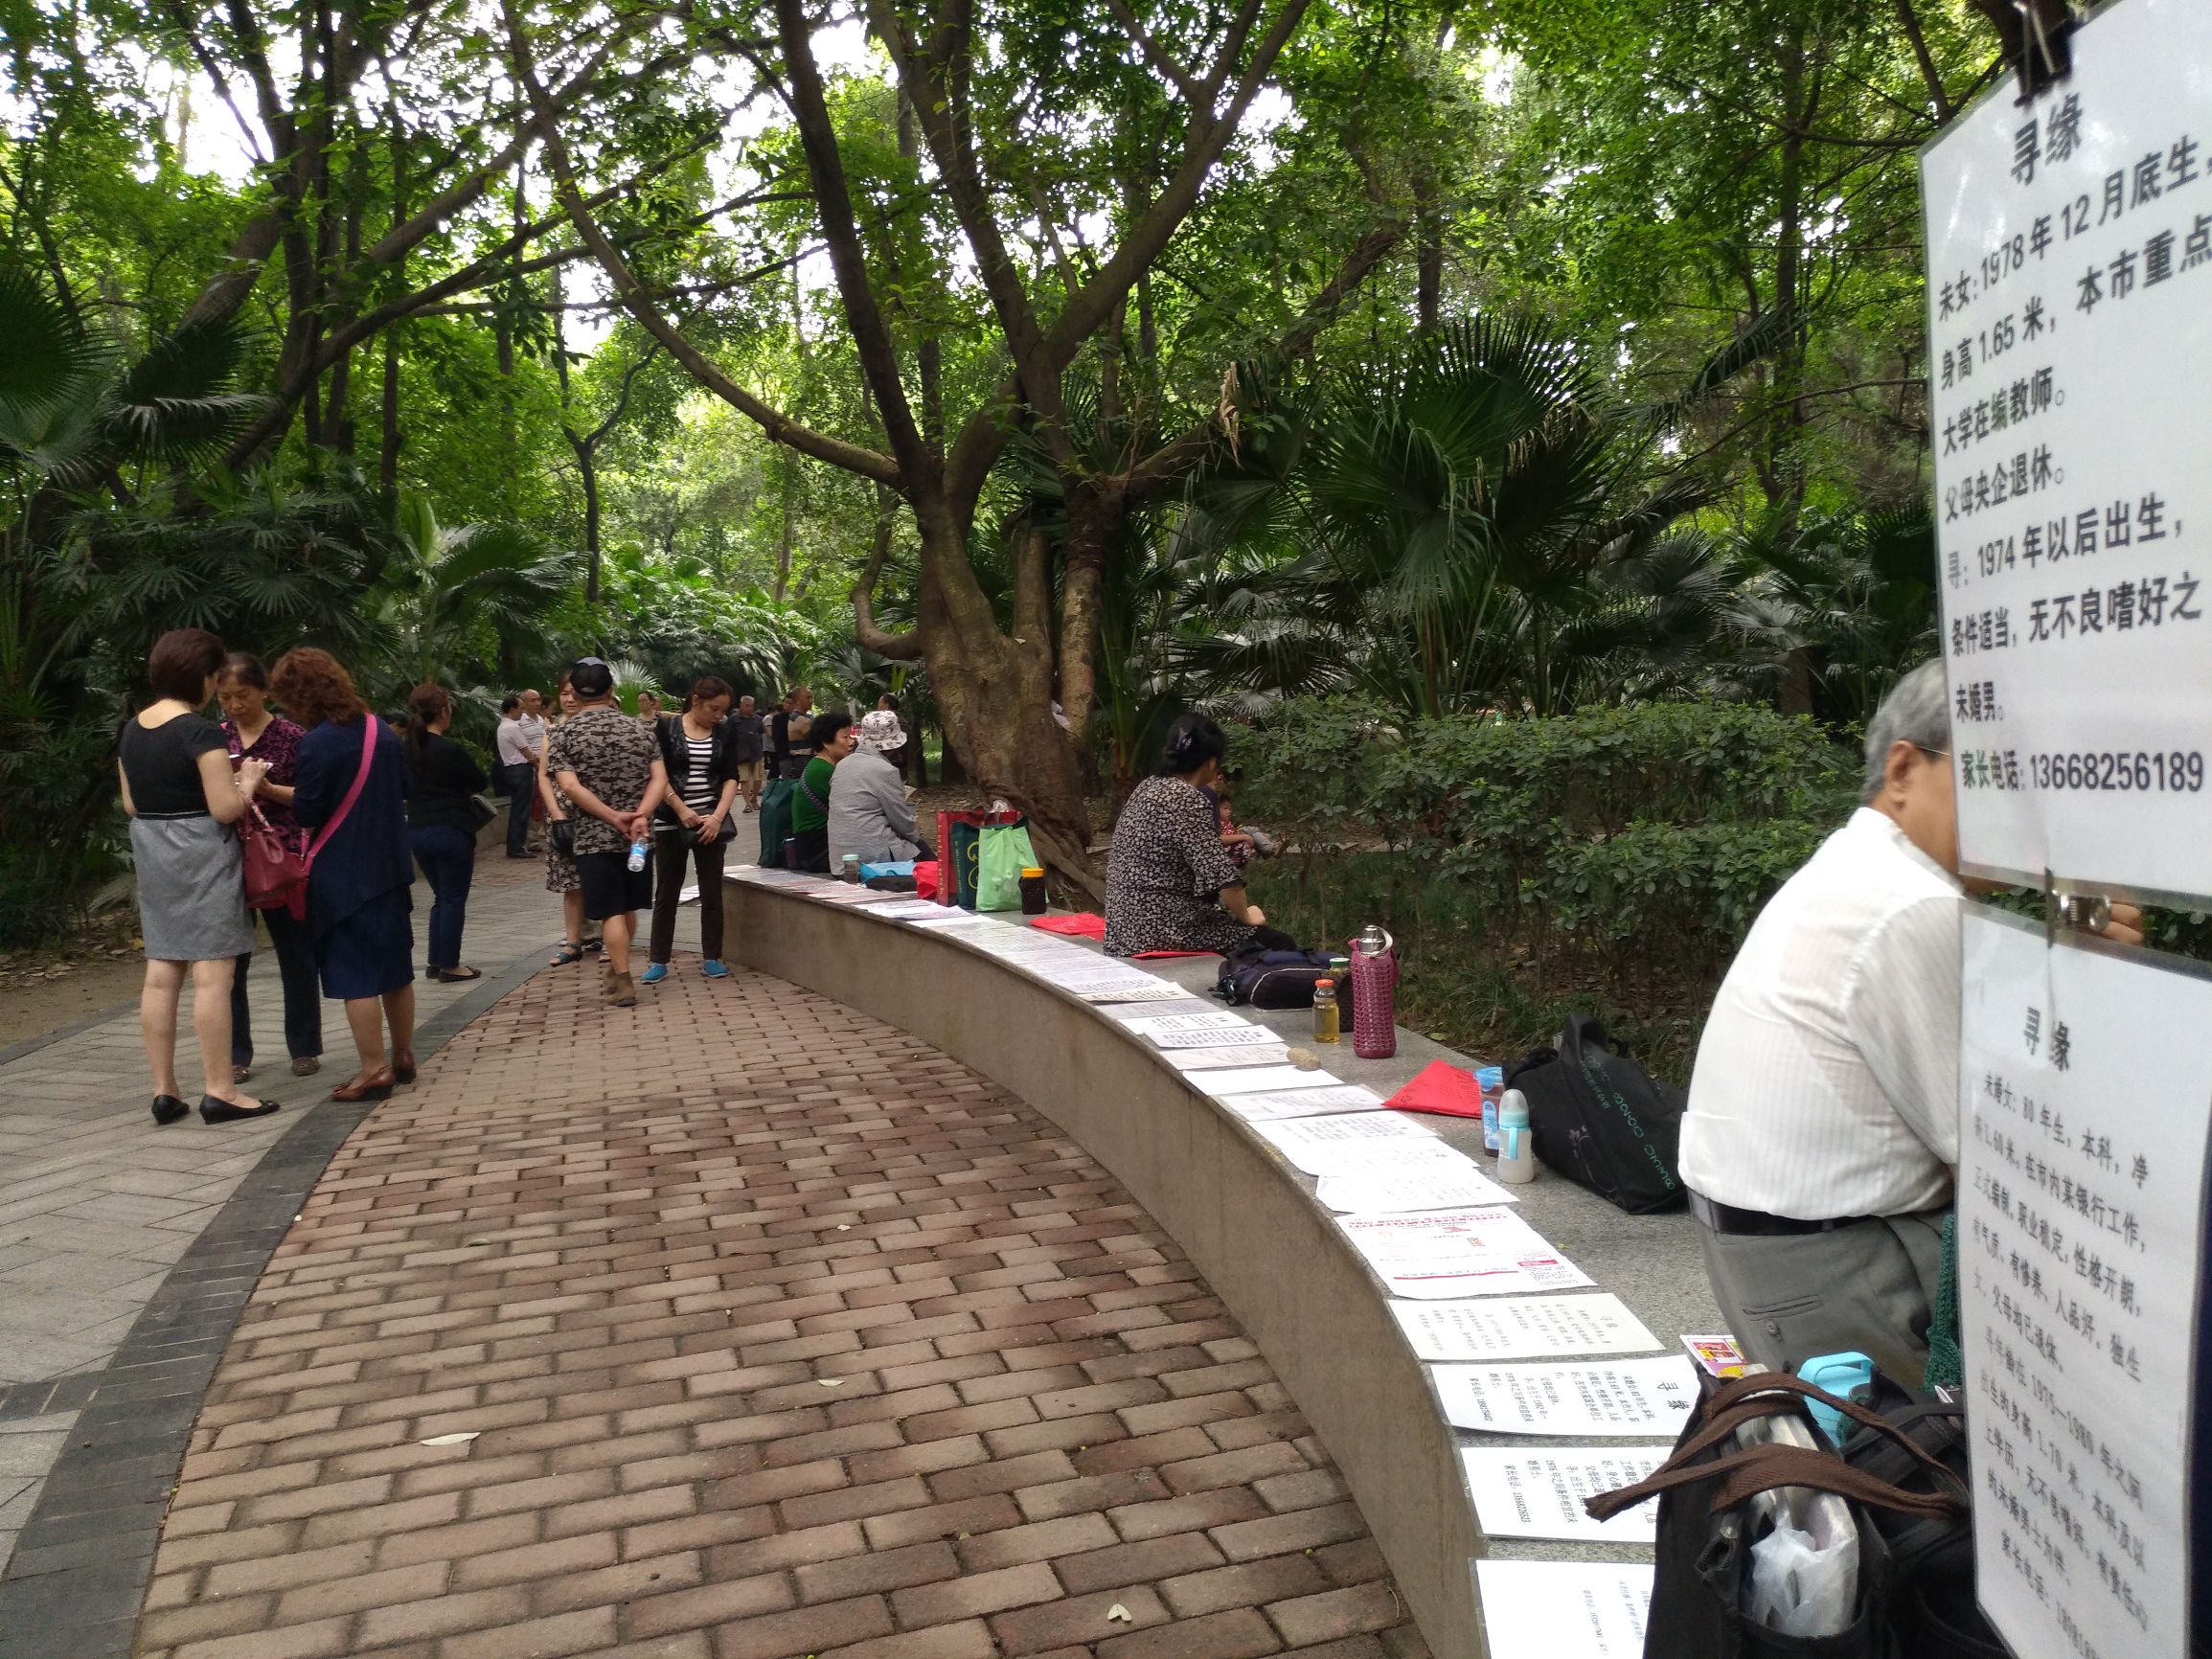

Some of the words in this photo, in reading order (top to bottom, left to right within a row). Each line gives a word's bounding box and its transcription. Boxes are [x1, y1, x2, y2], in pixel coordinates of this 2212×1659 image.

[2011, 93, 2083, 186] 寻缘
[1943, 366, 2064, 457] 大学在编教师。
[1946, 443, 2064, 524] 父母央企退休。
[1956, 681, 2004, 722] 未婚男。
[2023, 1006, 2070, 1072] 寻缘
